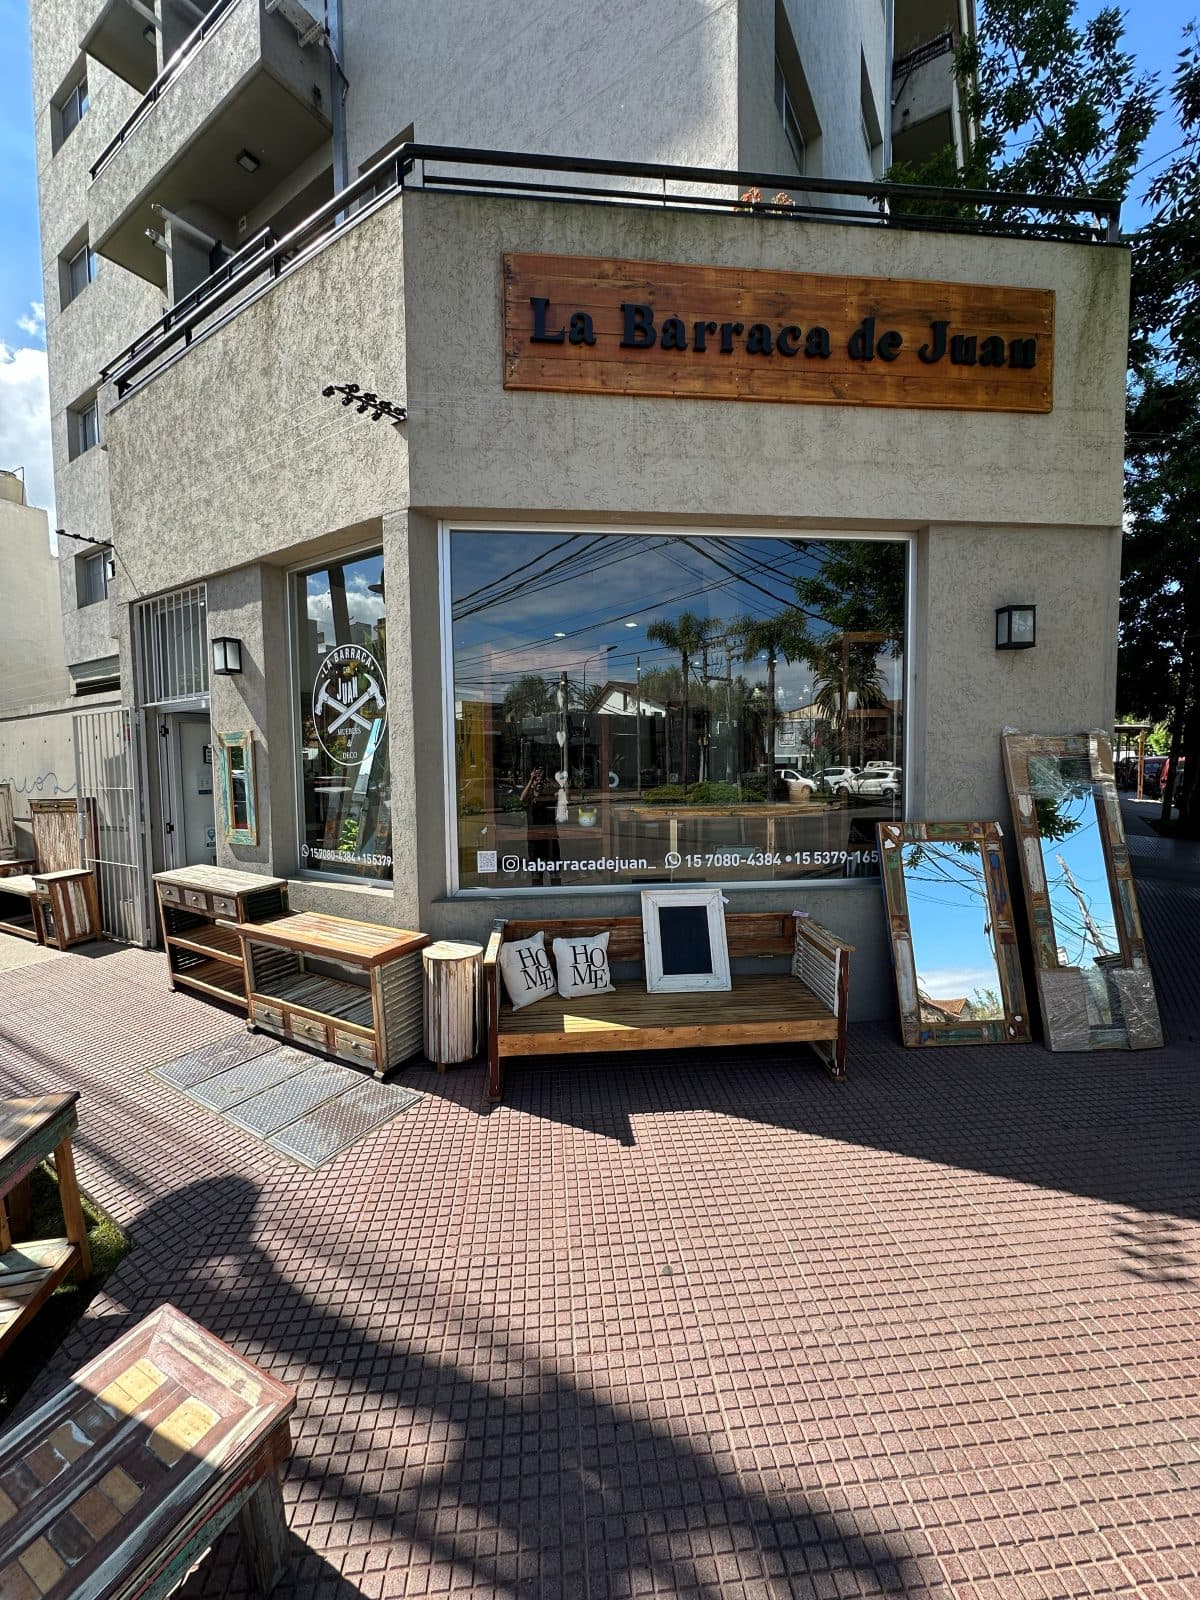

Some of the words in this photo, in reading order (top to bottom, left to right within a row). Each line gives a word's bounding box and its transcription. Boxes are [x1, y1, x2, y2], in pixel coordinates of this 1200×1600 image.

[530, 297, 596, 345] La
[620, 304, 832, 358] Barraca
[848, 317, 903, 361] de
[919, 320, 1037, 369] Juan
[322, 660, 332, 674] LA
[334, 648, 371, 667] BARRACA
[336, 675, 358, 704] JUAN
[685, 854, 702, 868] 15
[705, 853, 782, 867] 7080-4384
